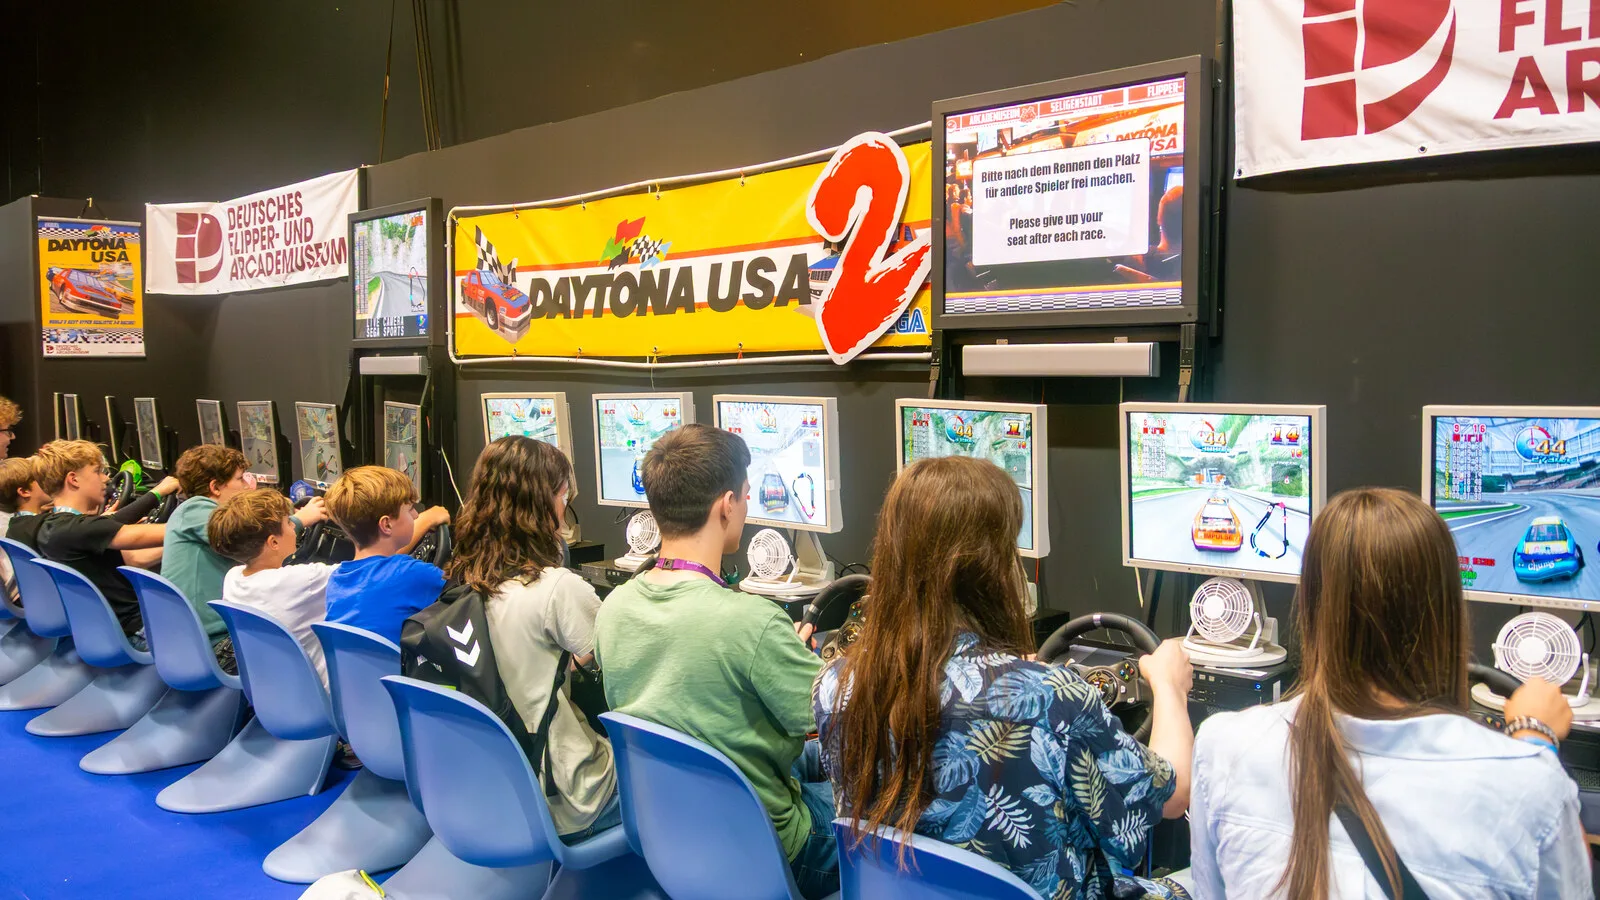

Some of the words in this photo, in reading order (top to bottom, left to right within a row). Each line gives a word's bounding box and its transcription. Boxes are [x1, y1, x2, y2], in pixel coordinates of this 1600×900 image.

[1493, 47, 1600, 120] AR
[981, 170, 1003, 183] Bitte
[1005, 167, 1028, 180] nach
[1030, 165, 1051, 177] dem
[1053, 160, 1091, 174] Rennen
[1093, 157, 1113, 169] den
[1115, 153, 1141, 167] Platz
[985, 186, 998, 198] für
[1000, 184, 1033, 197] andere
[1035, 180, 1069, 194] Spieler
[1071, 176, 1088, 189] frei
[1090, 173, 1136, 187] machen.
[227, 191, 303, 230] DEUTSCHES
[1009, 217, 1041, 230] Please
[1043, 215, 1064, 228] give
[1066, 213, 1078, 225] up
[1080, 211, 1104, 224] your
[48, 237, 127, 251] DAYTONA
[228, 225, 280, 256] FLIPPER-
[284, 217, 313, 246] UND
[1007, 234, 1028, 246] seat
[1029, 233, 1053, 244] after
[1054, 230, 1078, 243] each
[1080, 229, 1106, 241] race.
[811, 138, 931, 356] 2
[91, 250, 129, 263] USA
[230, 237, 347, 280] ARCADEMUSEUM
[529, 266, 696, 320] DAYTONA
[707, 253, 812, 312] USA
[366, 317, 380, 327] LIVE
[383, 315, 404, 327] CAMERA
[366, 326, 380, 337] SEGA
[383, 326, 404, 337] SPORTS
[956, 425, 973, 438] 44
[1204, 432, 1227, 446] 44
[1272, 426, 1300, 443] 14
[1535, 439, 1567, 455] 44
